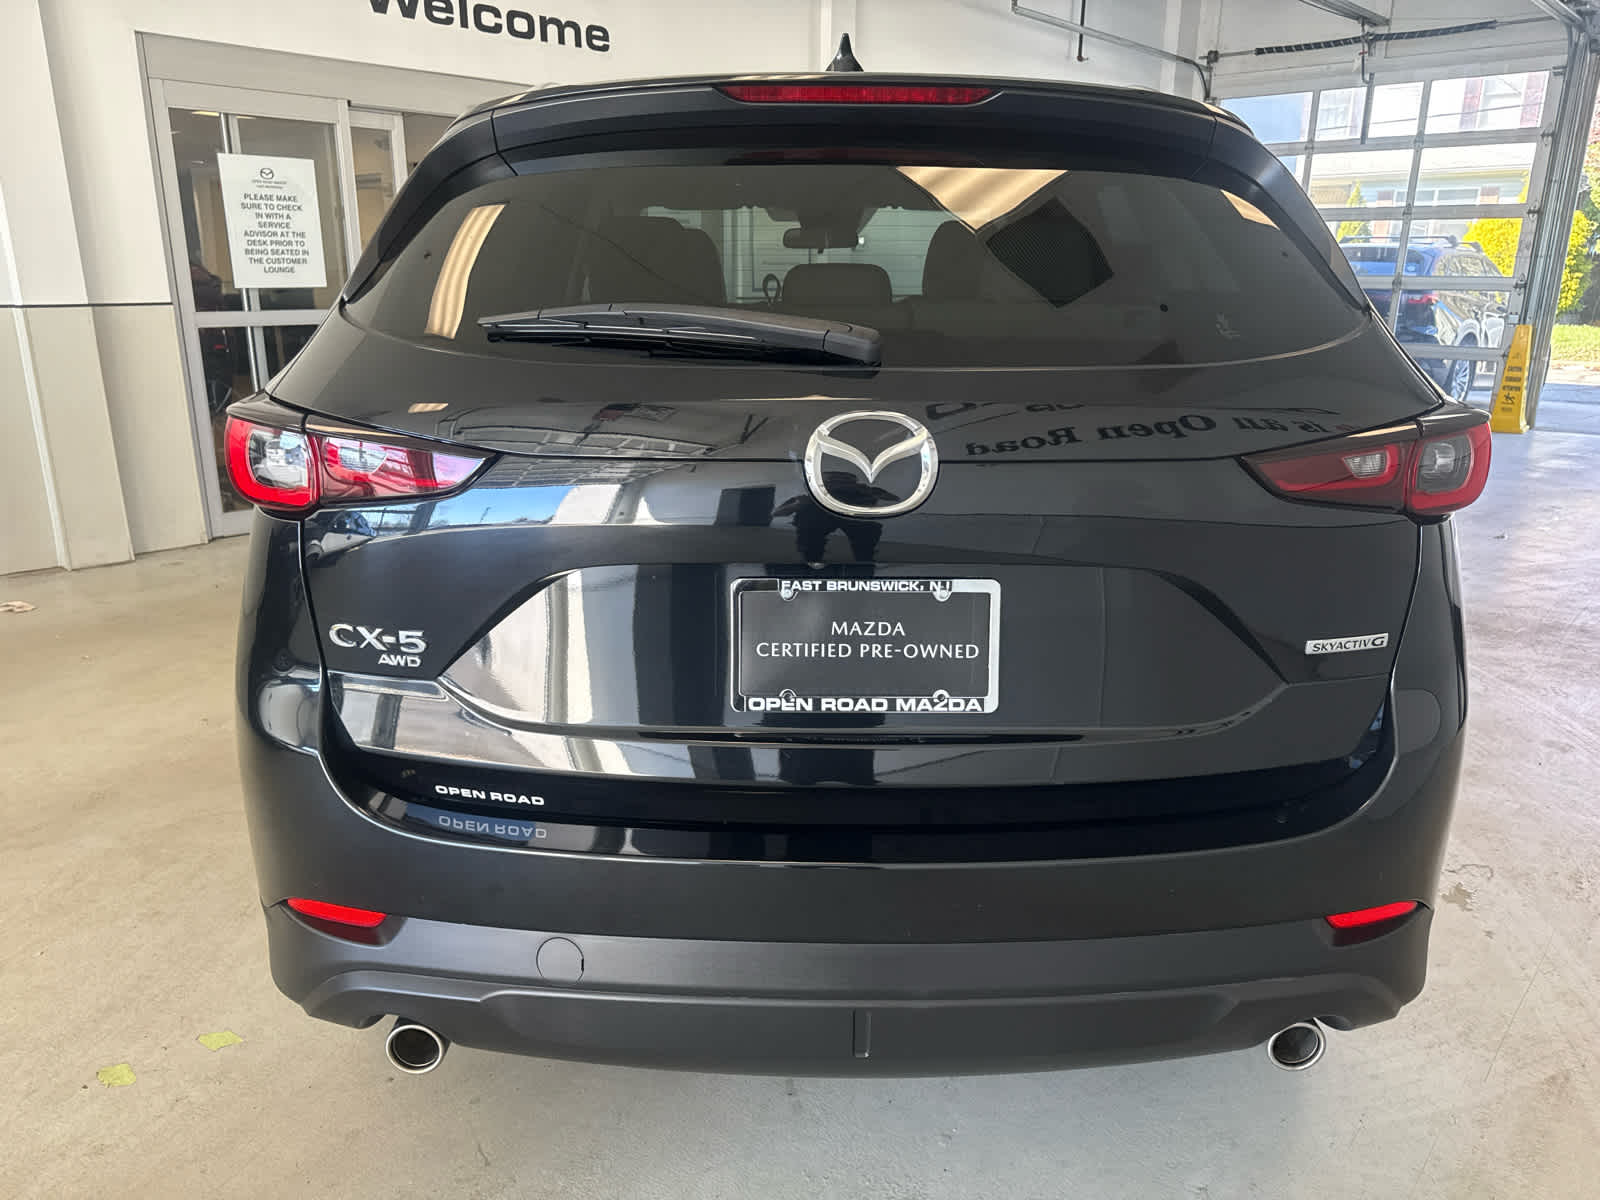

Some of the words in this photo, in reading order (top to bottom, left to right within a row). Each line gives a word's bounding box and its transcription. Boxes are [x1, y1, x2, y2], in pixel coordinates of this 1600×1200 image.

[243, 193, 274, 202] PLEASE
[275, 194, 298, 203] MAKE
[240, 202, 262, 210] SURE
[264, 203, 275, 211] TO
[276, 203, 303, 212] CHECK
[255, 212, 263, 220] IN
[264, 212, 284, 220] WITH
[257, 221, 291, 229] SERVICE
[243, 230, 278, 238] ADVISOR
[279, 230, 289, 238] AT
[291, 231, 306, 239] THE
[246, 239, 269, 247] DESK
[270, 239, 293, 247] PRIOR
[244, 248, 269, 256] BEING
[270, 248, 301, 256] SEATED
[248, 257, 264, 265] THE
[265, 257, 308, 265] CUSTOMER
[826, 580, 924, 591] BRUNSWICK,
[831, 621, 906, 636] MAZDA
[328, 623, 427, 654] CX-5
[756, 642, 852, 657] CERTIFIED
[860, 643, 980, 659] PRE-OWNED
[377, 653, 421, 668] AWD
[748, 697, 813, 712] OPEN
[821, 697, 888, 712] ROAD
[896, 697, 985, 712] MAZDA
[435, 785, 486, 800] OPEN
[489, 791, 545, 806] ROAD
